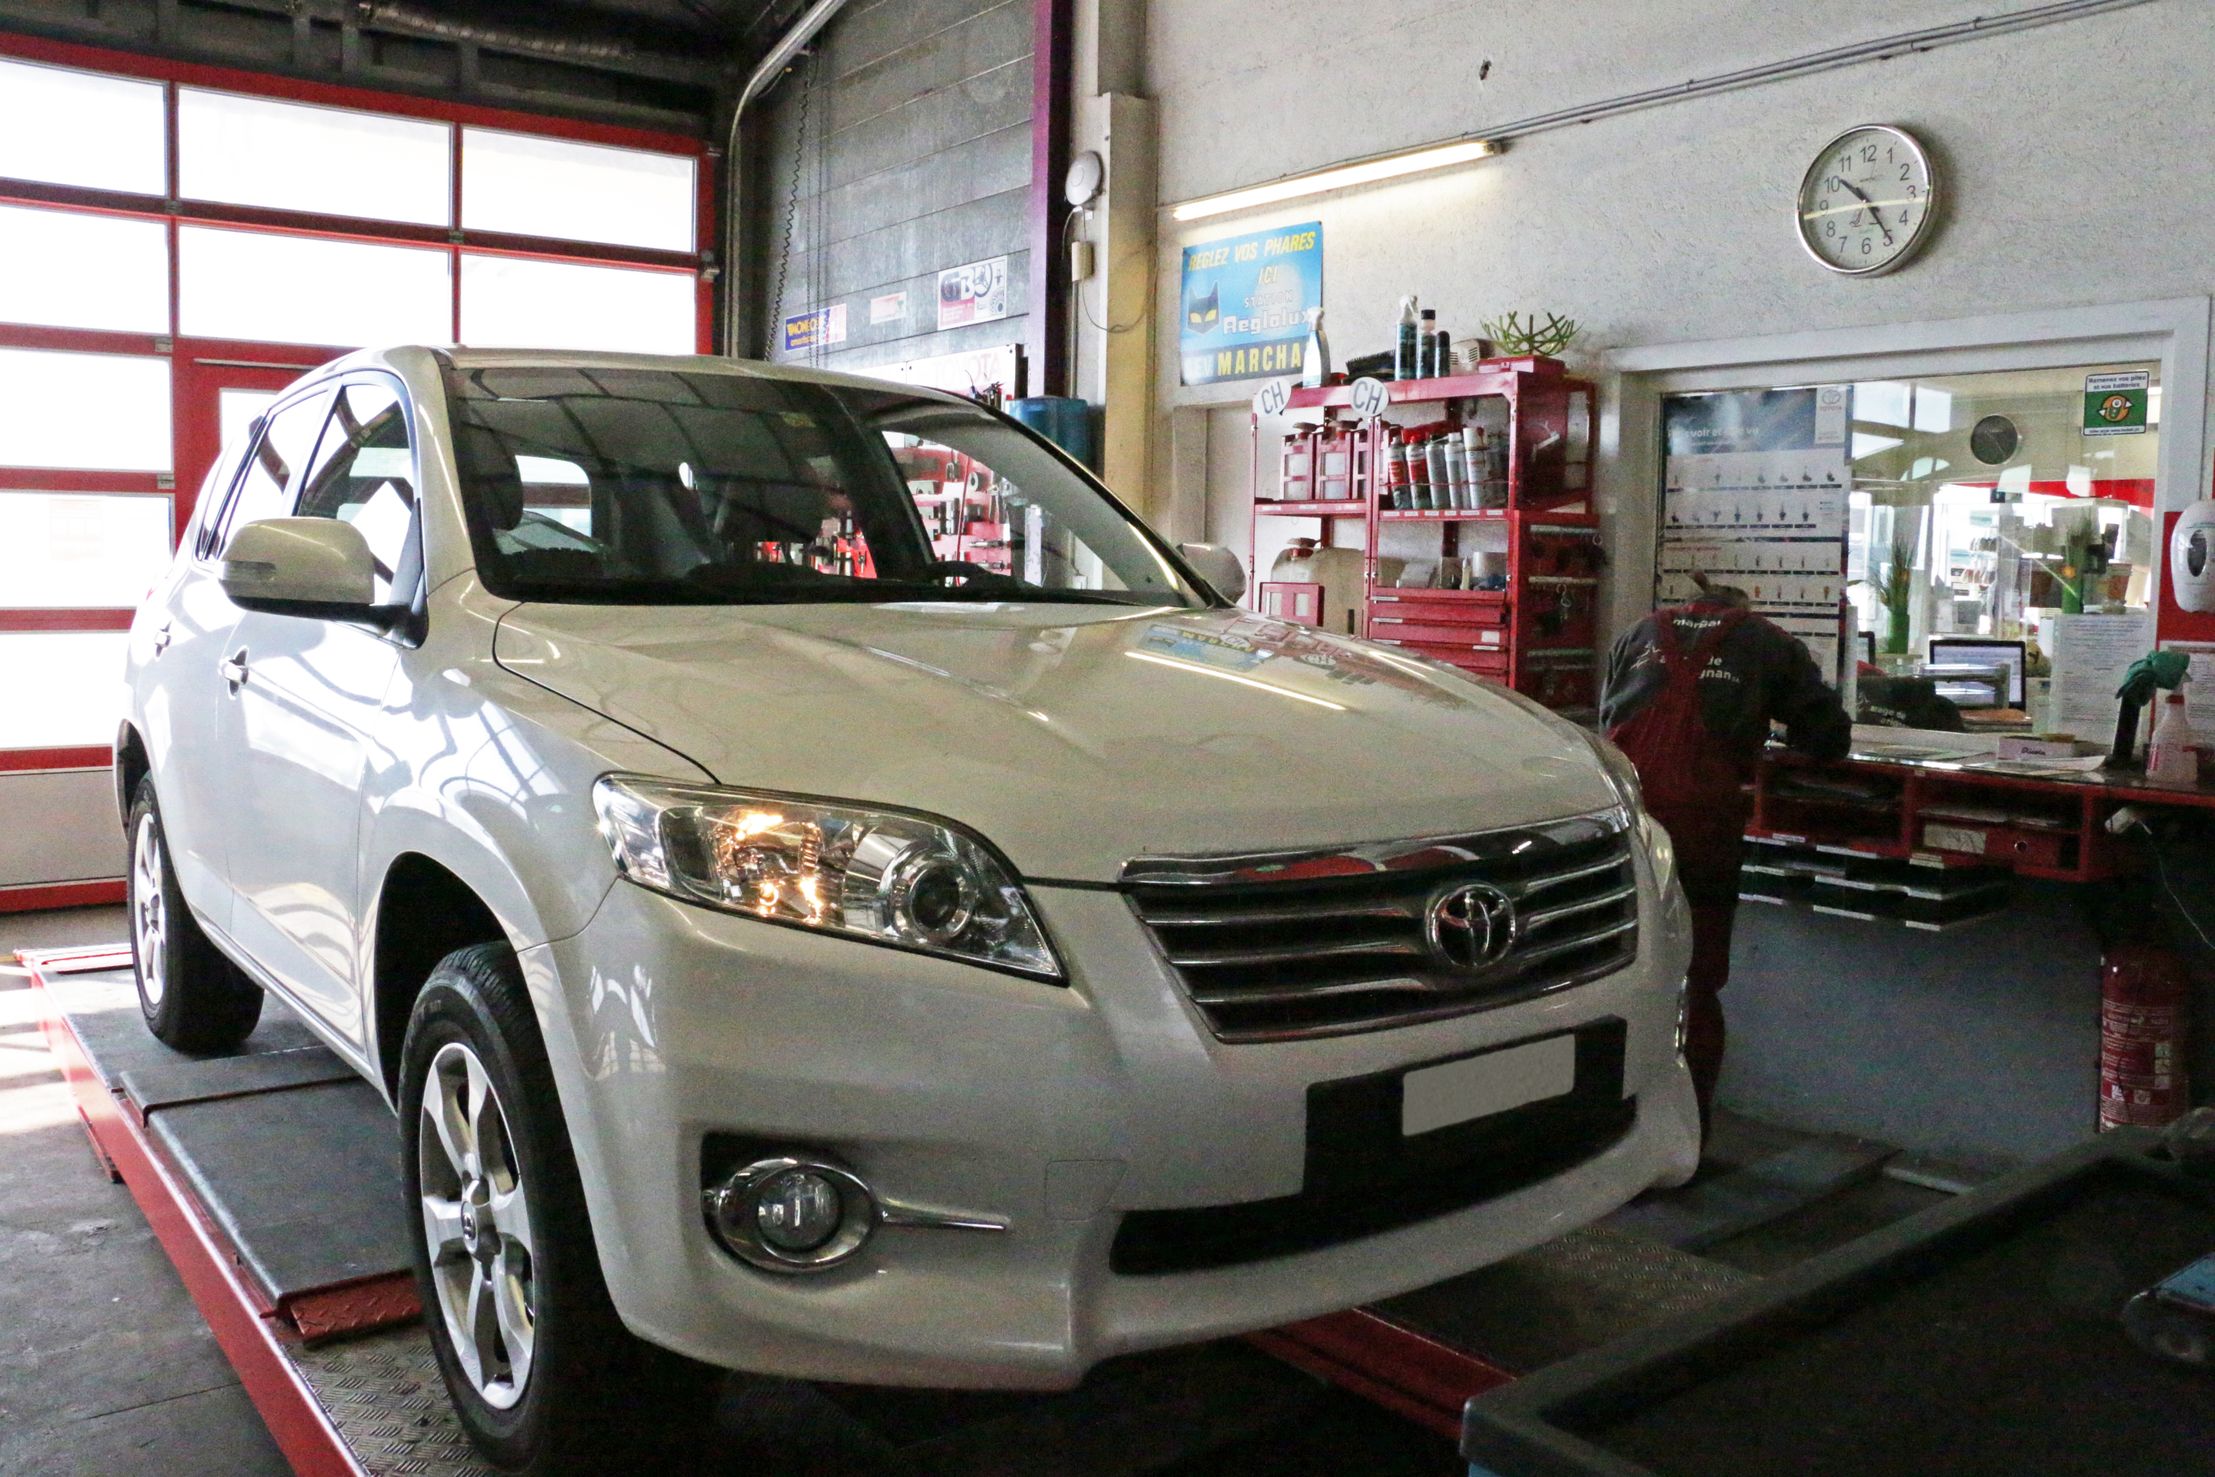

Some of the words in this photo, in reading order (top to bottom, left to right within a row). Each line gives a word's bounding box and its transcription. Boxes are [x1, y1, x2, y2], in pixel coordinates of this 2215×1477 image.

[1860, 145, 1877, 163] 12
[1886, 147, 1894, 164] 1
[1838, 155, 1851, 172] 11
[1900, 163, 1910, 181] 2
[1824, 175, 1840, 193] 10
[1906, 185, 1917, 201] 3
[1819, 199, 1829, 216] 9
[1899, 209, 1909, 226] 4
[1826, 221, 1836, 238] 8
[1883, 229, 1894, 247] 5
[1235, 241, 1258, 263] VOS
[1264, 231, 1316, 257] PHARES
[1838, 236, 1848, 253] 7
[1861, 238, 1871, 255] 6
[1258, 264, 1279, 284] ICI
[1217, 342, 1308, 376] MARCHA
[1261, 381, 1285, 414] CH
[1353, 380, 1383, 414] CH
